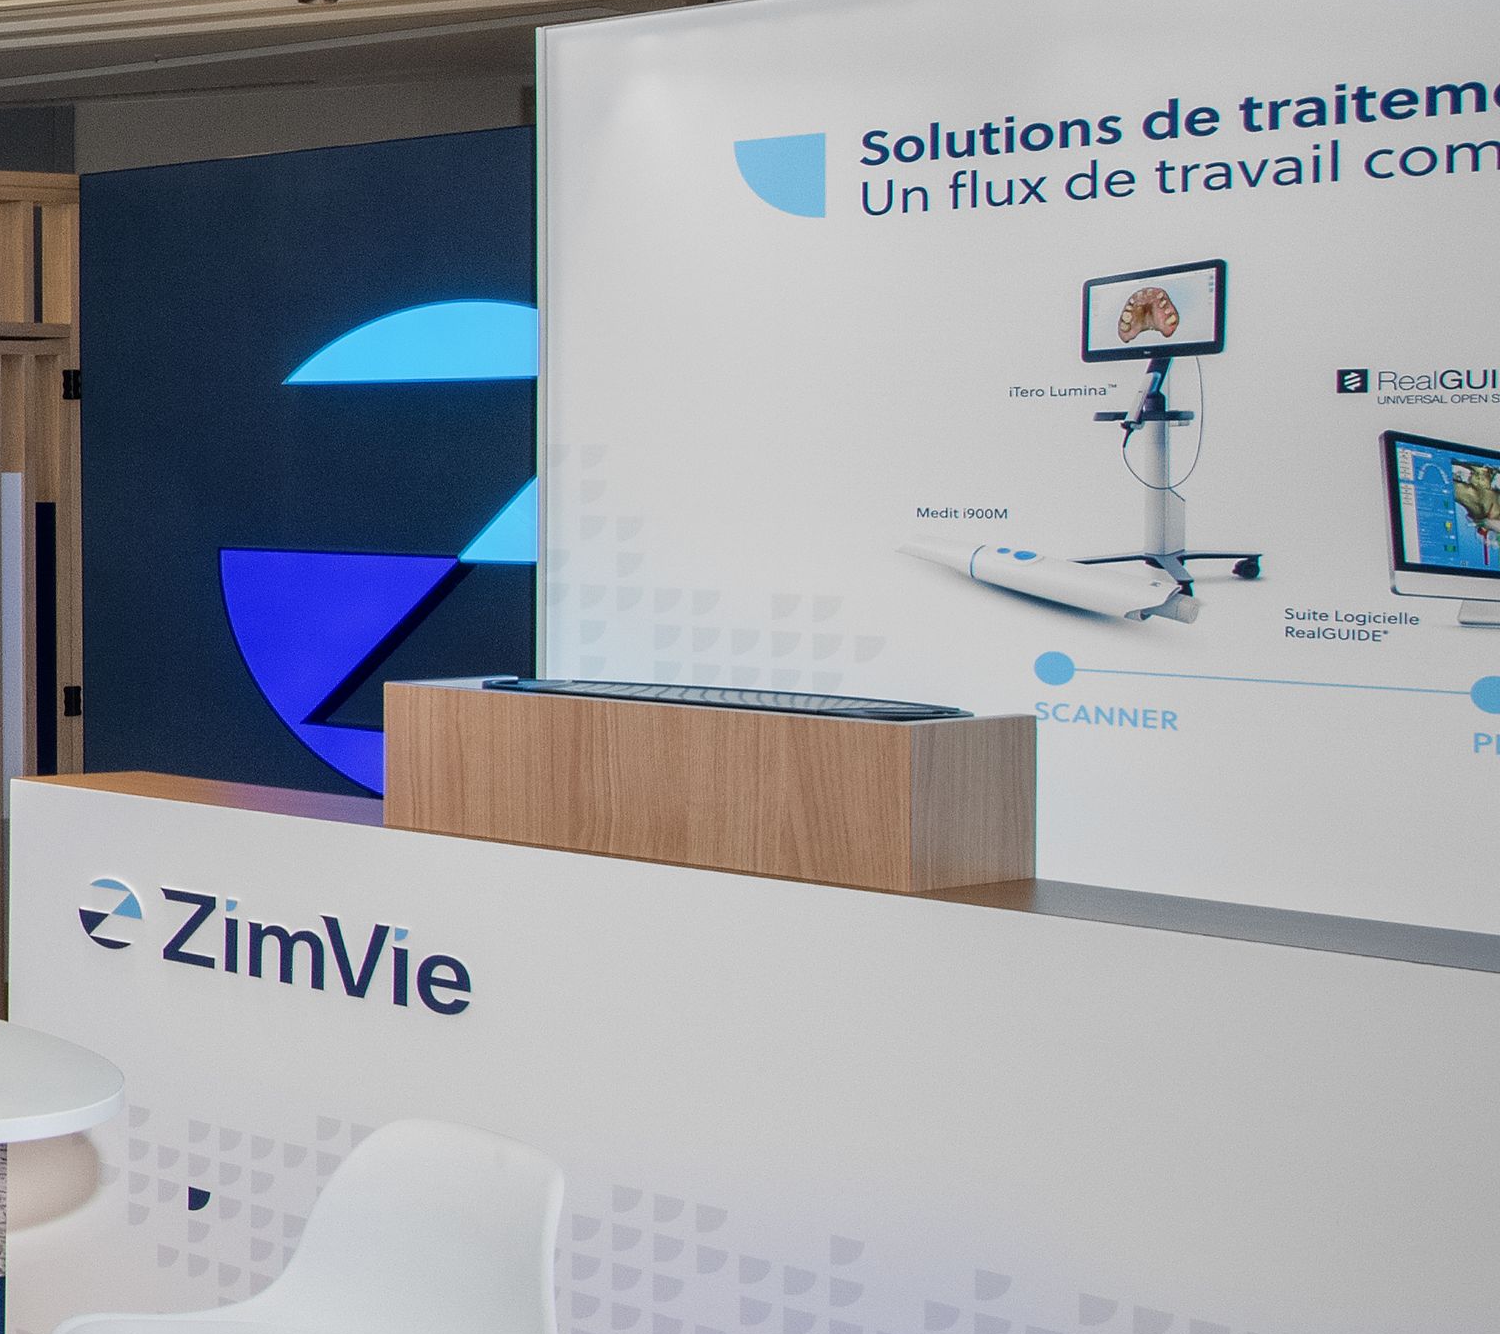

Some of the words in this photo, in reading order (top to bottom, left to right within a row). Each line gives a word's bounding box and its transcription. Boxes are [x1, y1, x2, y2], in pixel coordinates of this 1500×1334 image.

[860, 108, 1123, 167] Solutions
[1142, 98, 1220, 141] de
[1238, 78, 1500, 134] traitem
[861, 177, 930, 217] Un
[949, 167, 1047, 210] flux
[1064, 159, 1136, 200] de
[1156, 138, 1340, 195] travail
[1364, 139, 1500, 180] com
[1009, 386, 1045, 398] iTero
[1050, 383, 1117, 397] Lumina™
[1377, 394, 1448, 405] UNIVERSAL
[1451, 393, 1488, 404] OPEN
[916, 507, 959, 519] Medit
[963, 507, 1008, 519] i900M
[1284, 607, 1329, 621] Suite
[1335, 610, 1420, 626] Logicielle
[1034, 701, 1179, 732] SCANNER
[160, 886, 472, 1016] ZimVie
